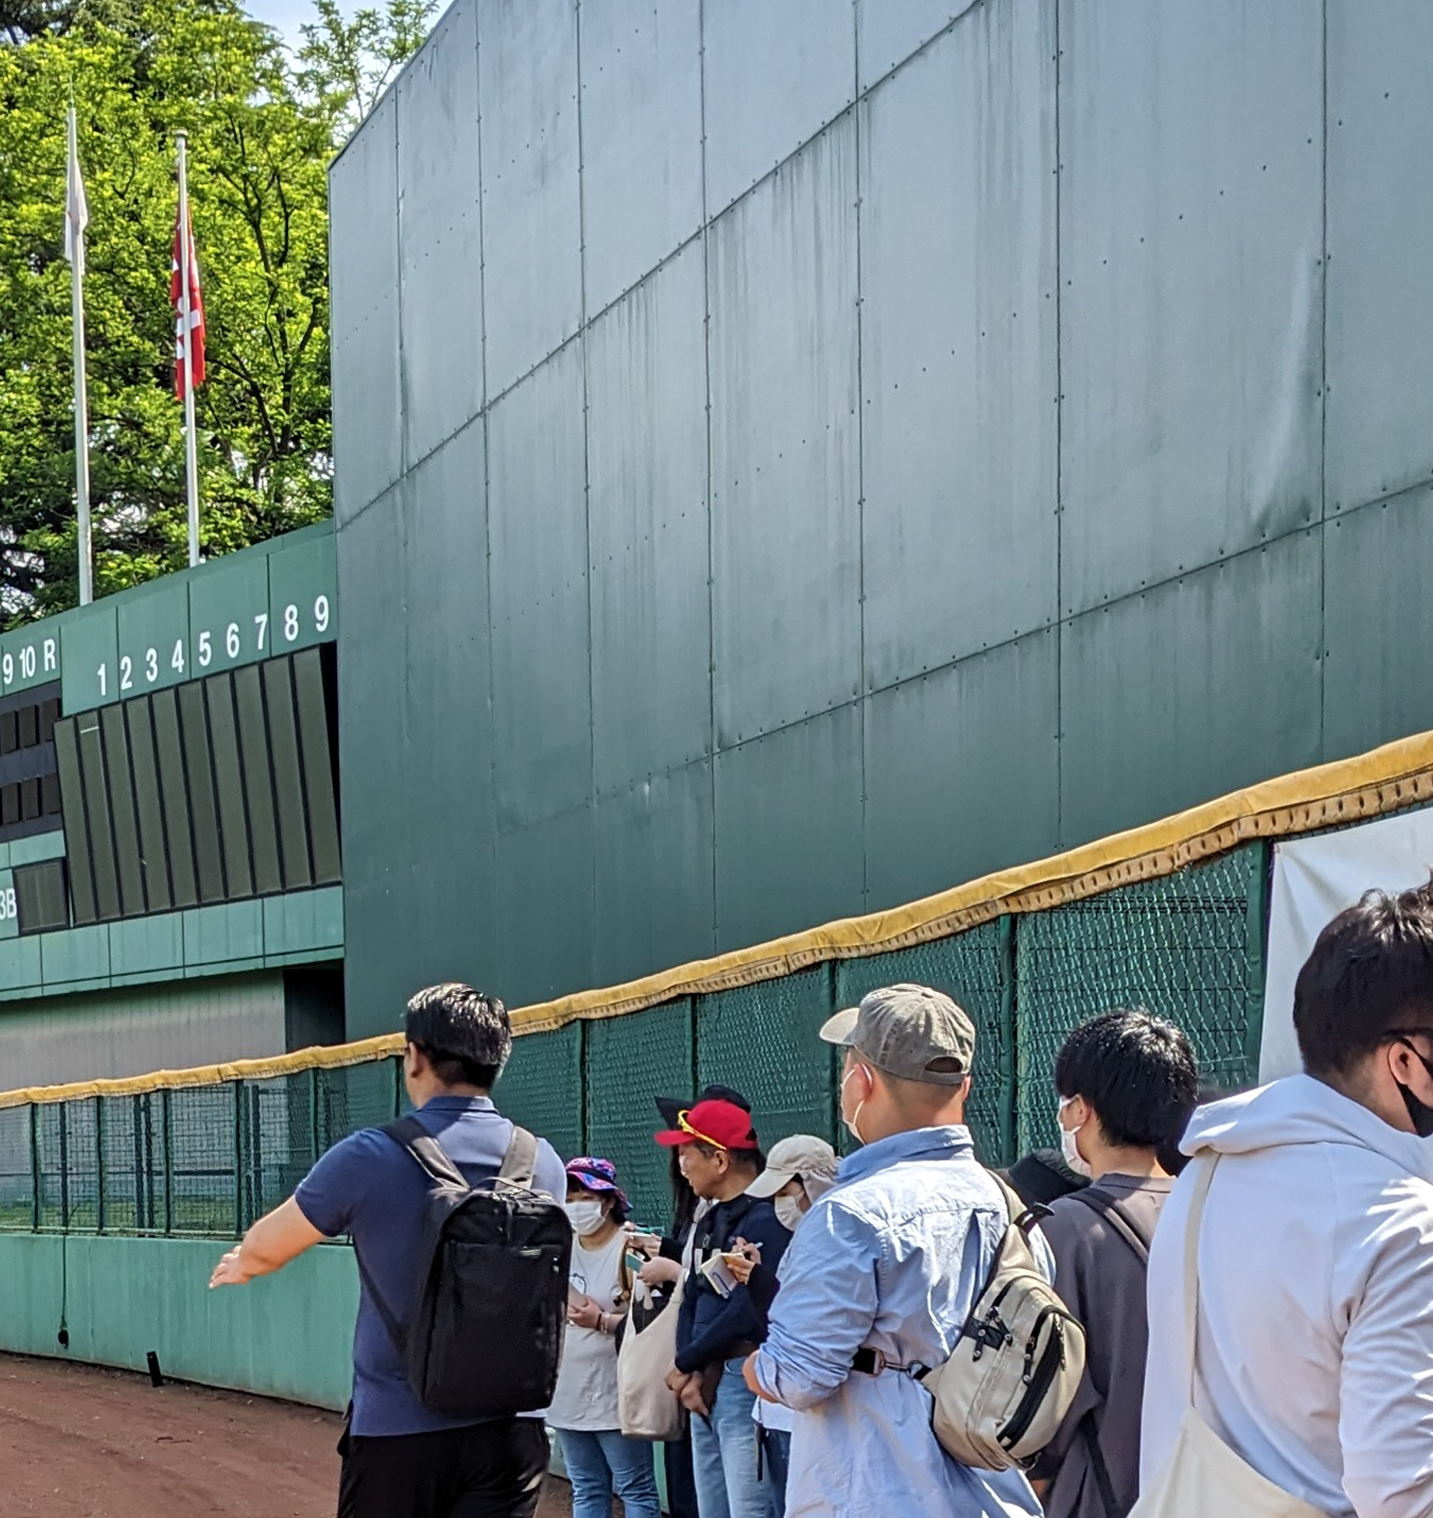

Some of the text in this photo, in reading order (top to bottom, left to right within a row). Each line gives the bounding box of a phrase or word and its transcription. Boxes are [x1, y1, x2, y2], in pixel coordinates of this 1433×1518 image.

[2, 653, 13, 685] 9
[19, 645, 36, 679] 10
[43, 639, 56, 671] R
[97, 595, 329, 696] 1 2 3 4 5 6 7 8 9
